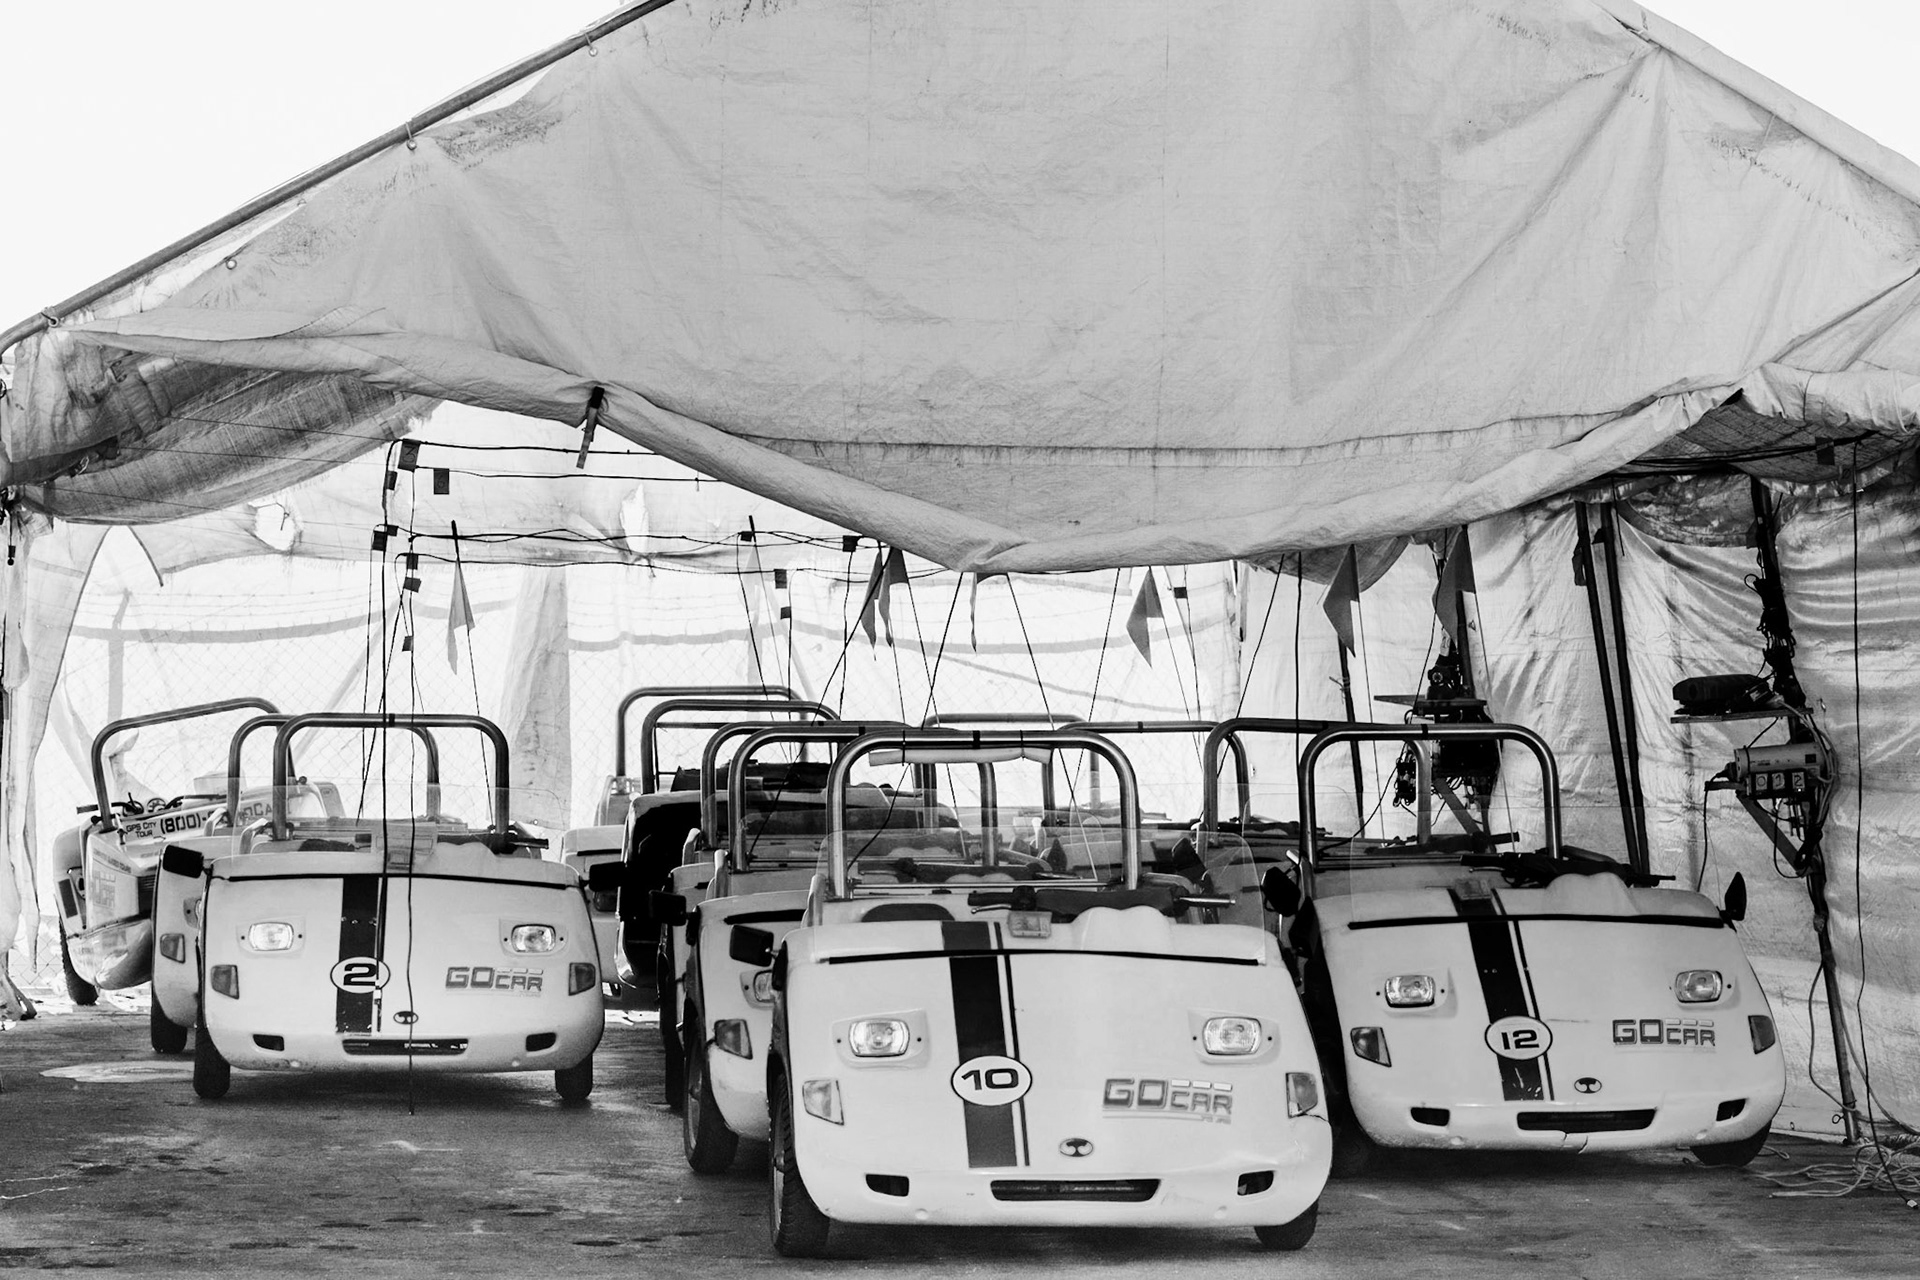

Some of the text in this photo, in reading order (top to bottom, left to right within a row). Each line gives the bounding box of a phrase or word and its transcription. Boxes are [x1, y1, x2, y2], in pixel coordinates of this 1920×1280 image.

[1794, 774, 1803, 787] 2
[126, 823, 142, 832] GPS
[343, 962, 377, 986] 2
[1501, 1029, 1540, 1050] 12
[961, 1068, 1019, 1091] 10
